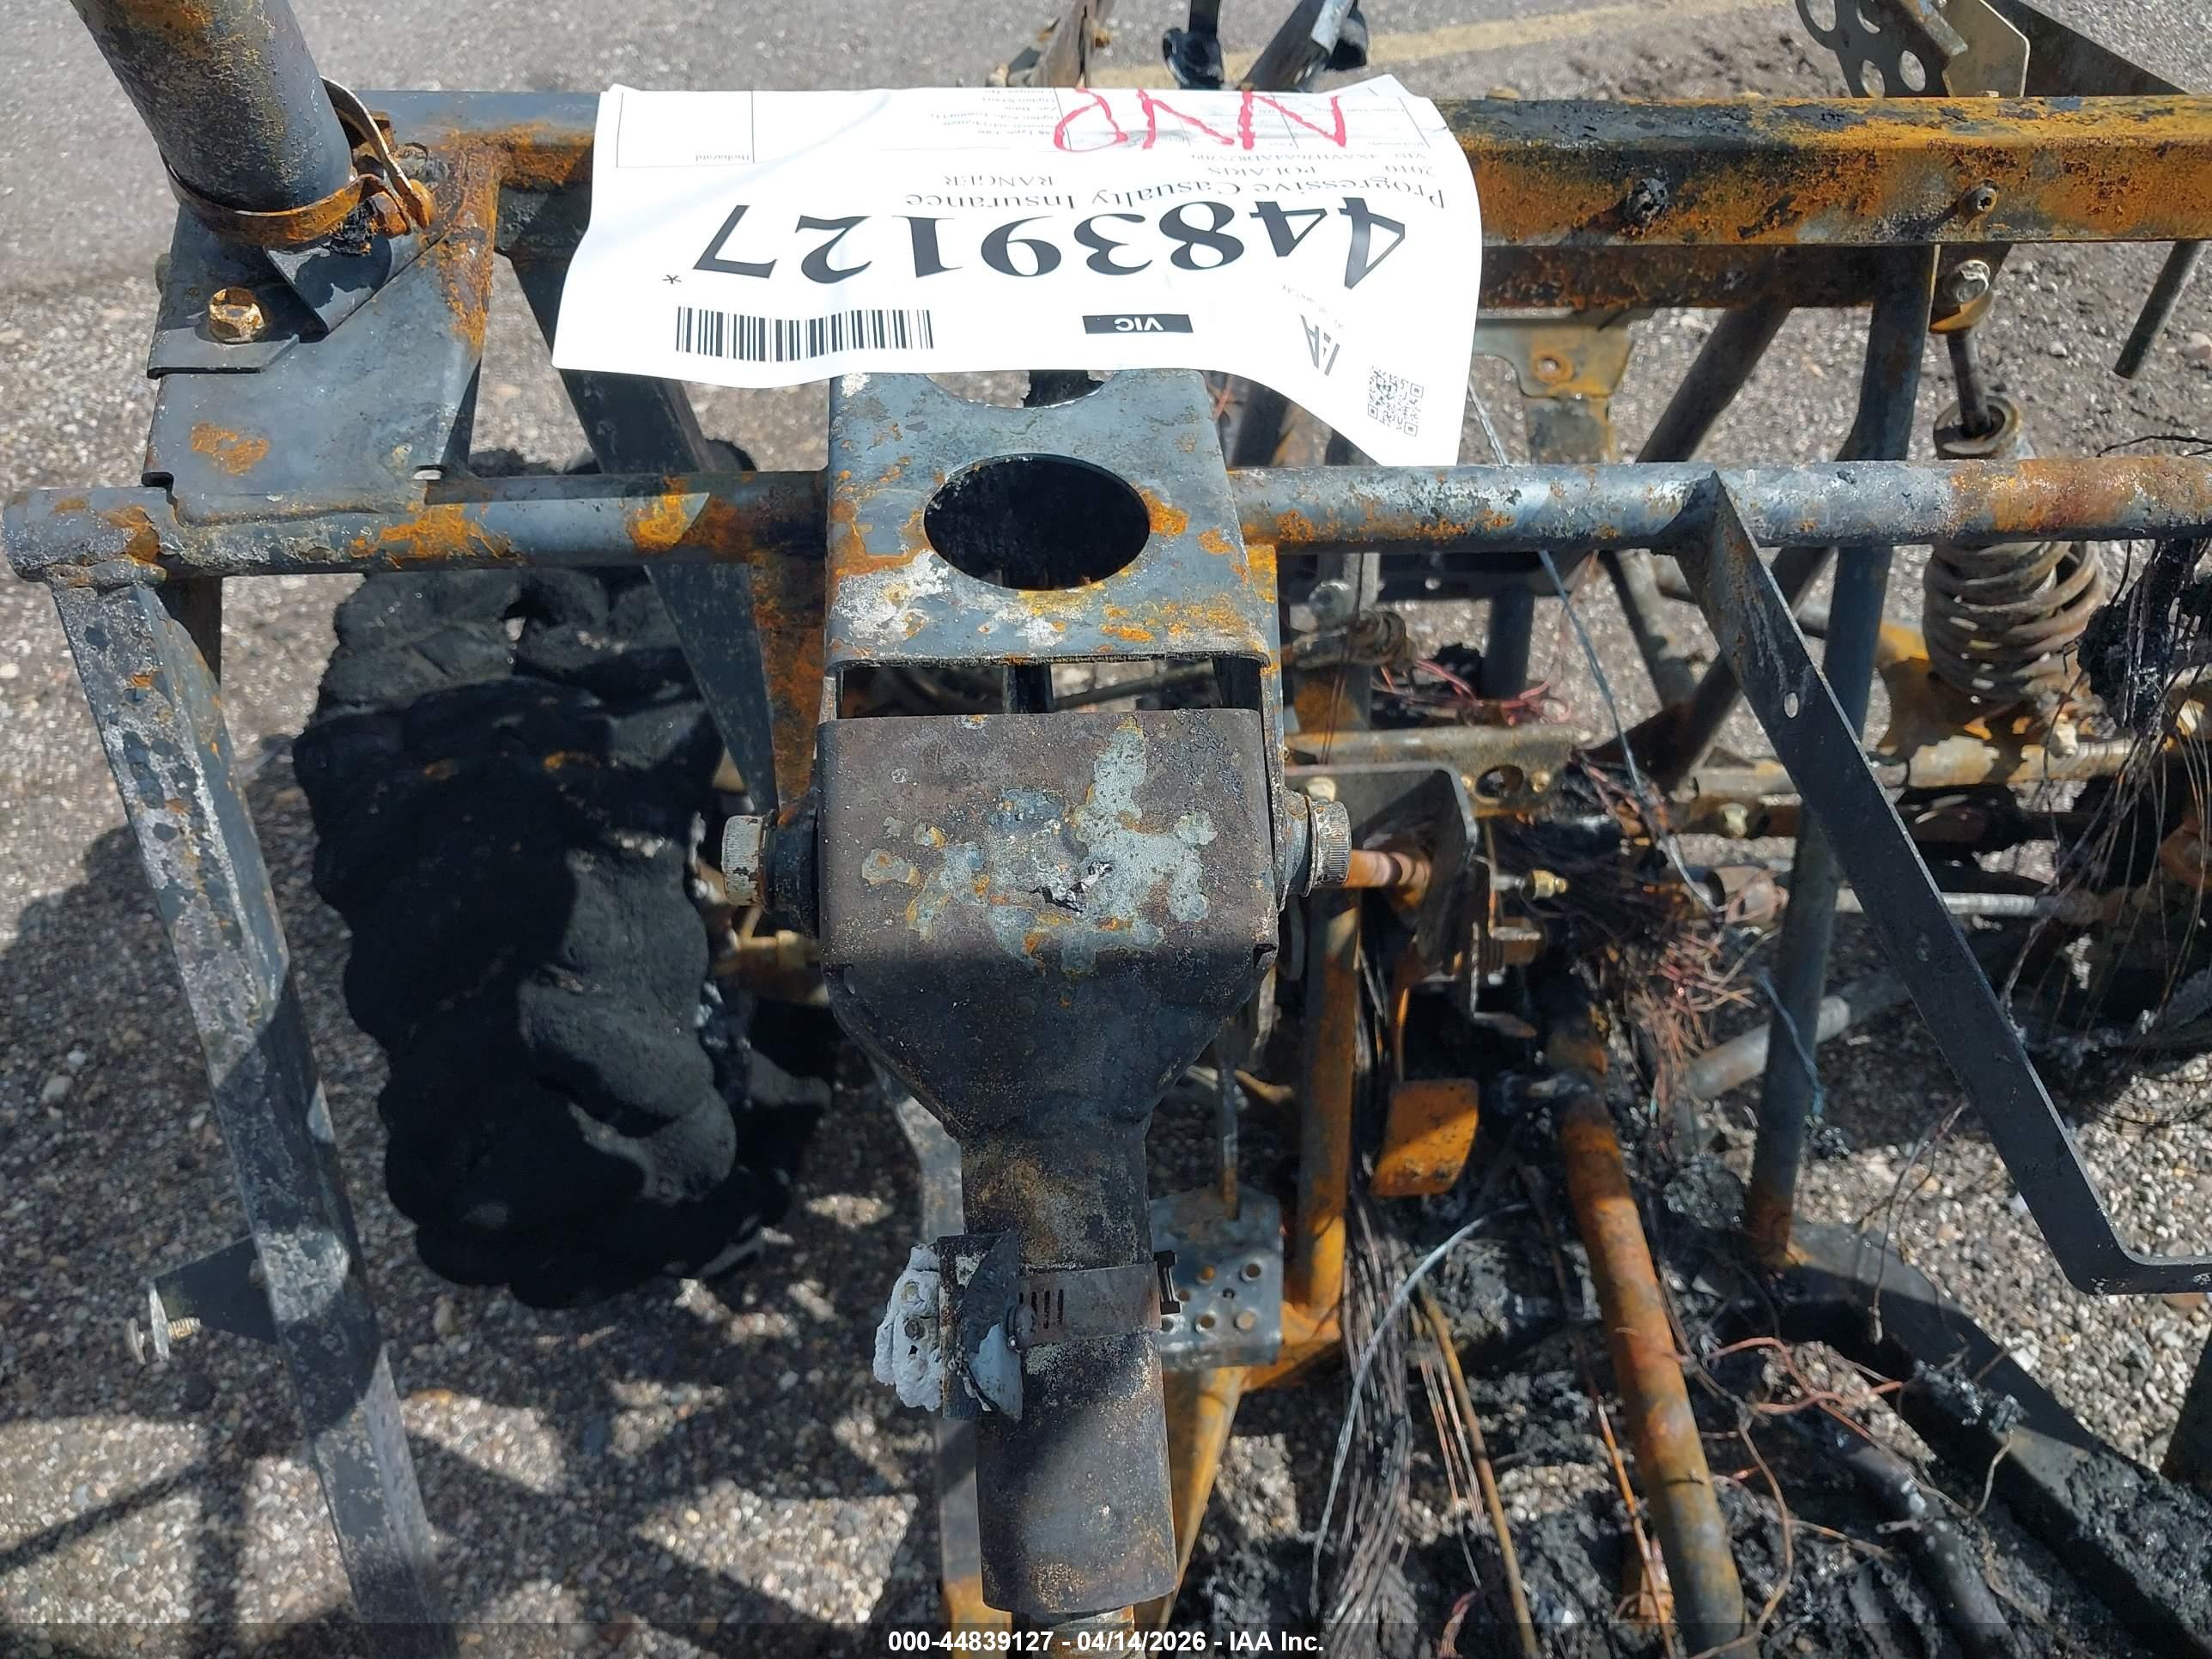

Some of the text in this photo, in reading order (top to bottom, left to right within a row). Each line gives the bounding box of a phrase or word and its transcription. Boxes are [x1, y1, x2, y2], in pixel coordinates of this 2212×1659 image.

[943, 174, 1054, 187] RANGER
[1206, 166, 1317, 177] POLARIS
[906, 175, 1446, 211] Progressive Casualty Insurance
[693, 197, 1406, 289] 44839127
[1115, 315, 1164, 333] VIC
